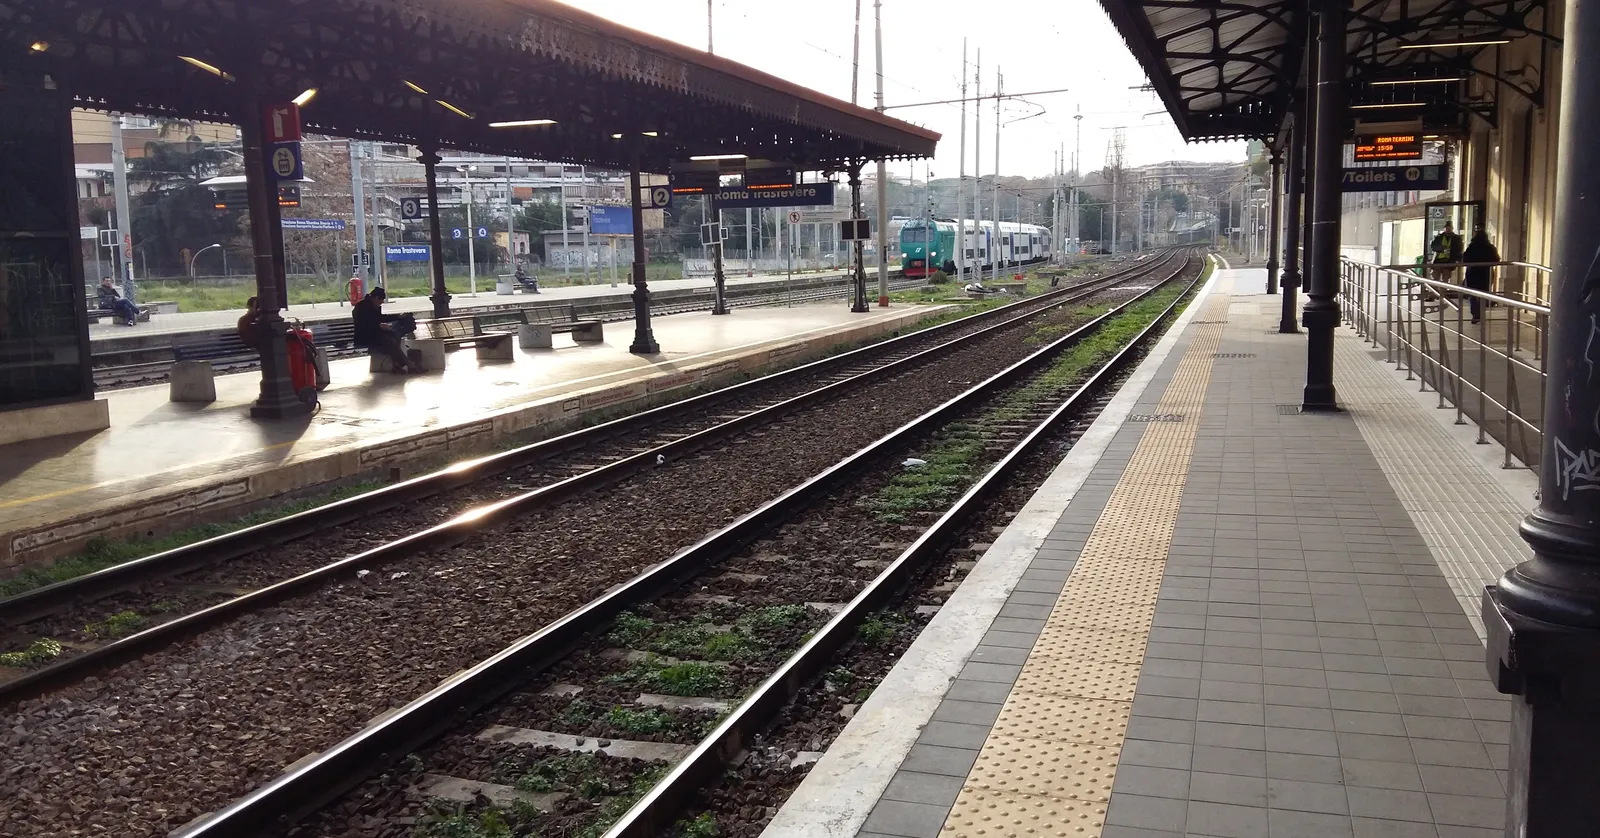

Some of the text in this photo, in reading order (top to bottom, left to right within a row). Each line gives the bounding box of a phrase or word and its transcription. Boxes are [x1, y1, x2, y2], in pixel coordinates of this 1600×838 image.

[657, 190, 666, 204] 2
[406, 202, 414, 214] 3
[402, 246, 426, 254] Trastevere
